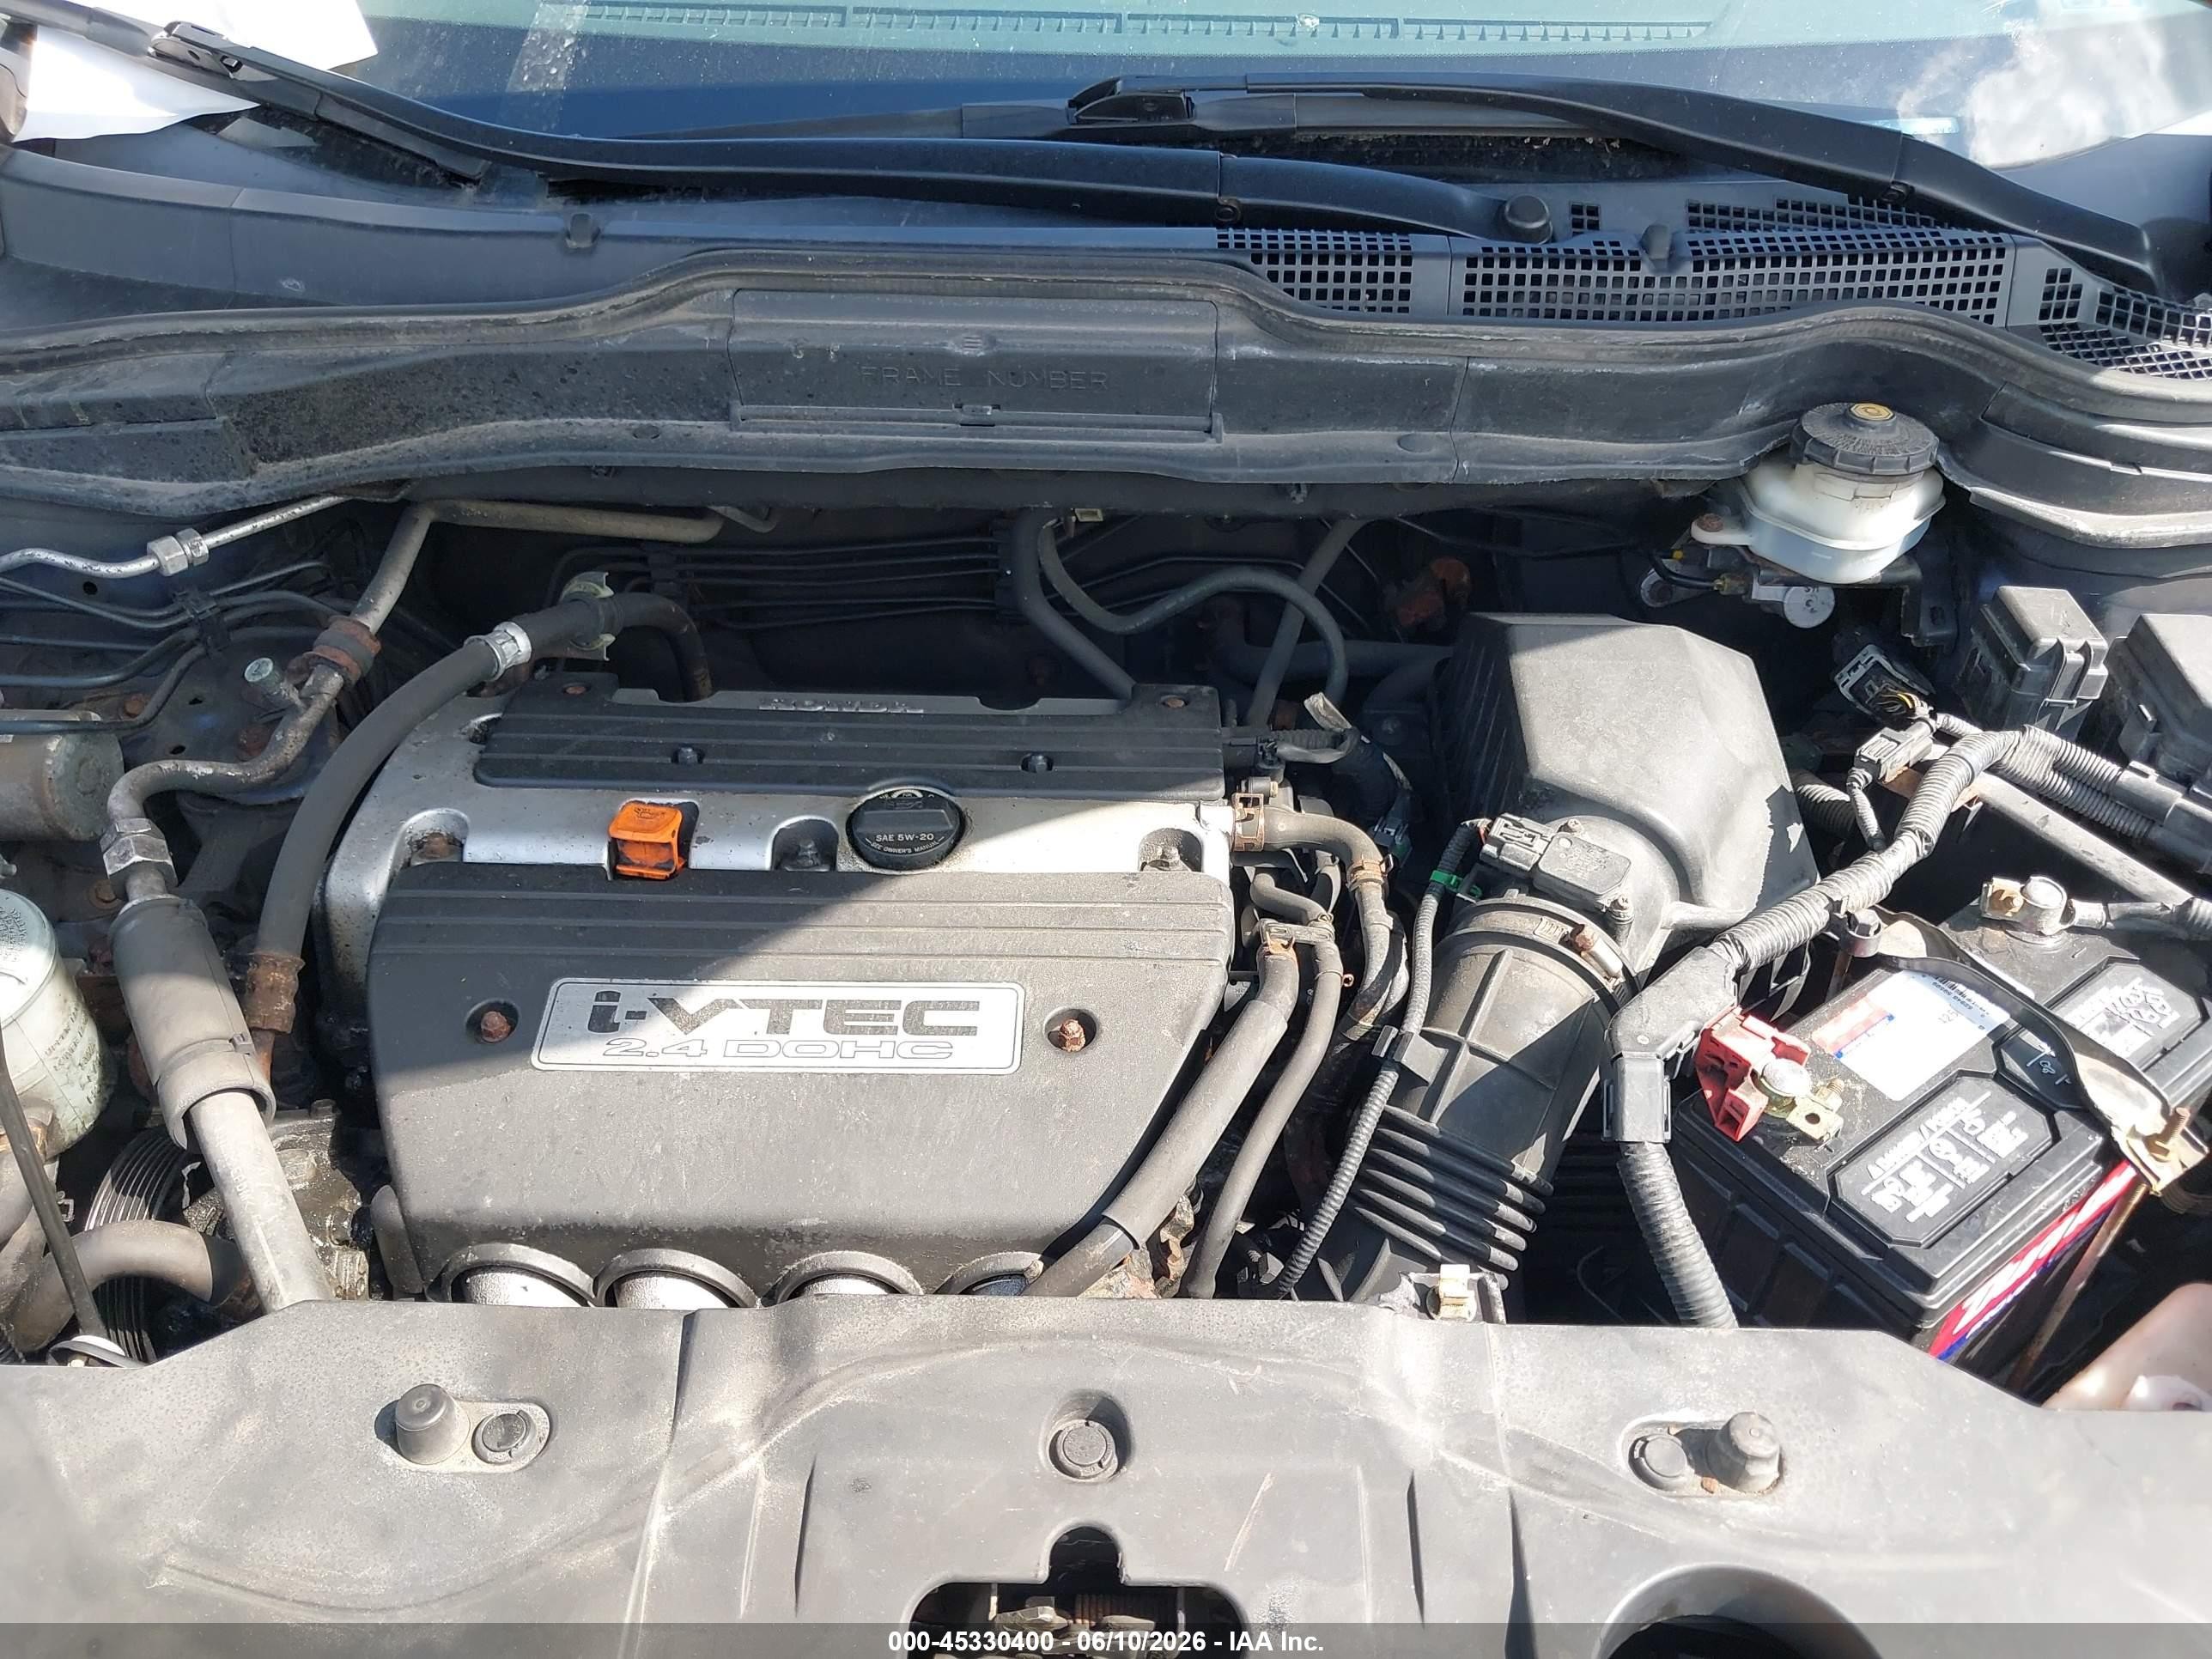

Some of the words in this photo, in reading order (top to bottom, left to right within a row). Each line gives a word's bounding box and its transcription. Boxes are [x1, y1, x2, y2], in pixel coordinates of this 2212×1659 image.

[860, 366, 962, 387] FRAME
[988, 368, 1109, 390] NUMBER
[871, 842, 882, 851] SEE
[883, 846, 912, 854] OWNER'S
[914, 840, 939, 853] MANUAL
[876, 834, 894, 842] SAE
[897, 833, 934, 842] 5W-20
[587, 989, 981, 1036] i-VTEC
[604, 1037, 708, 1058] 2.4
[724, 1039, 954, 1060] DOHC
